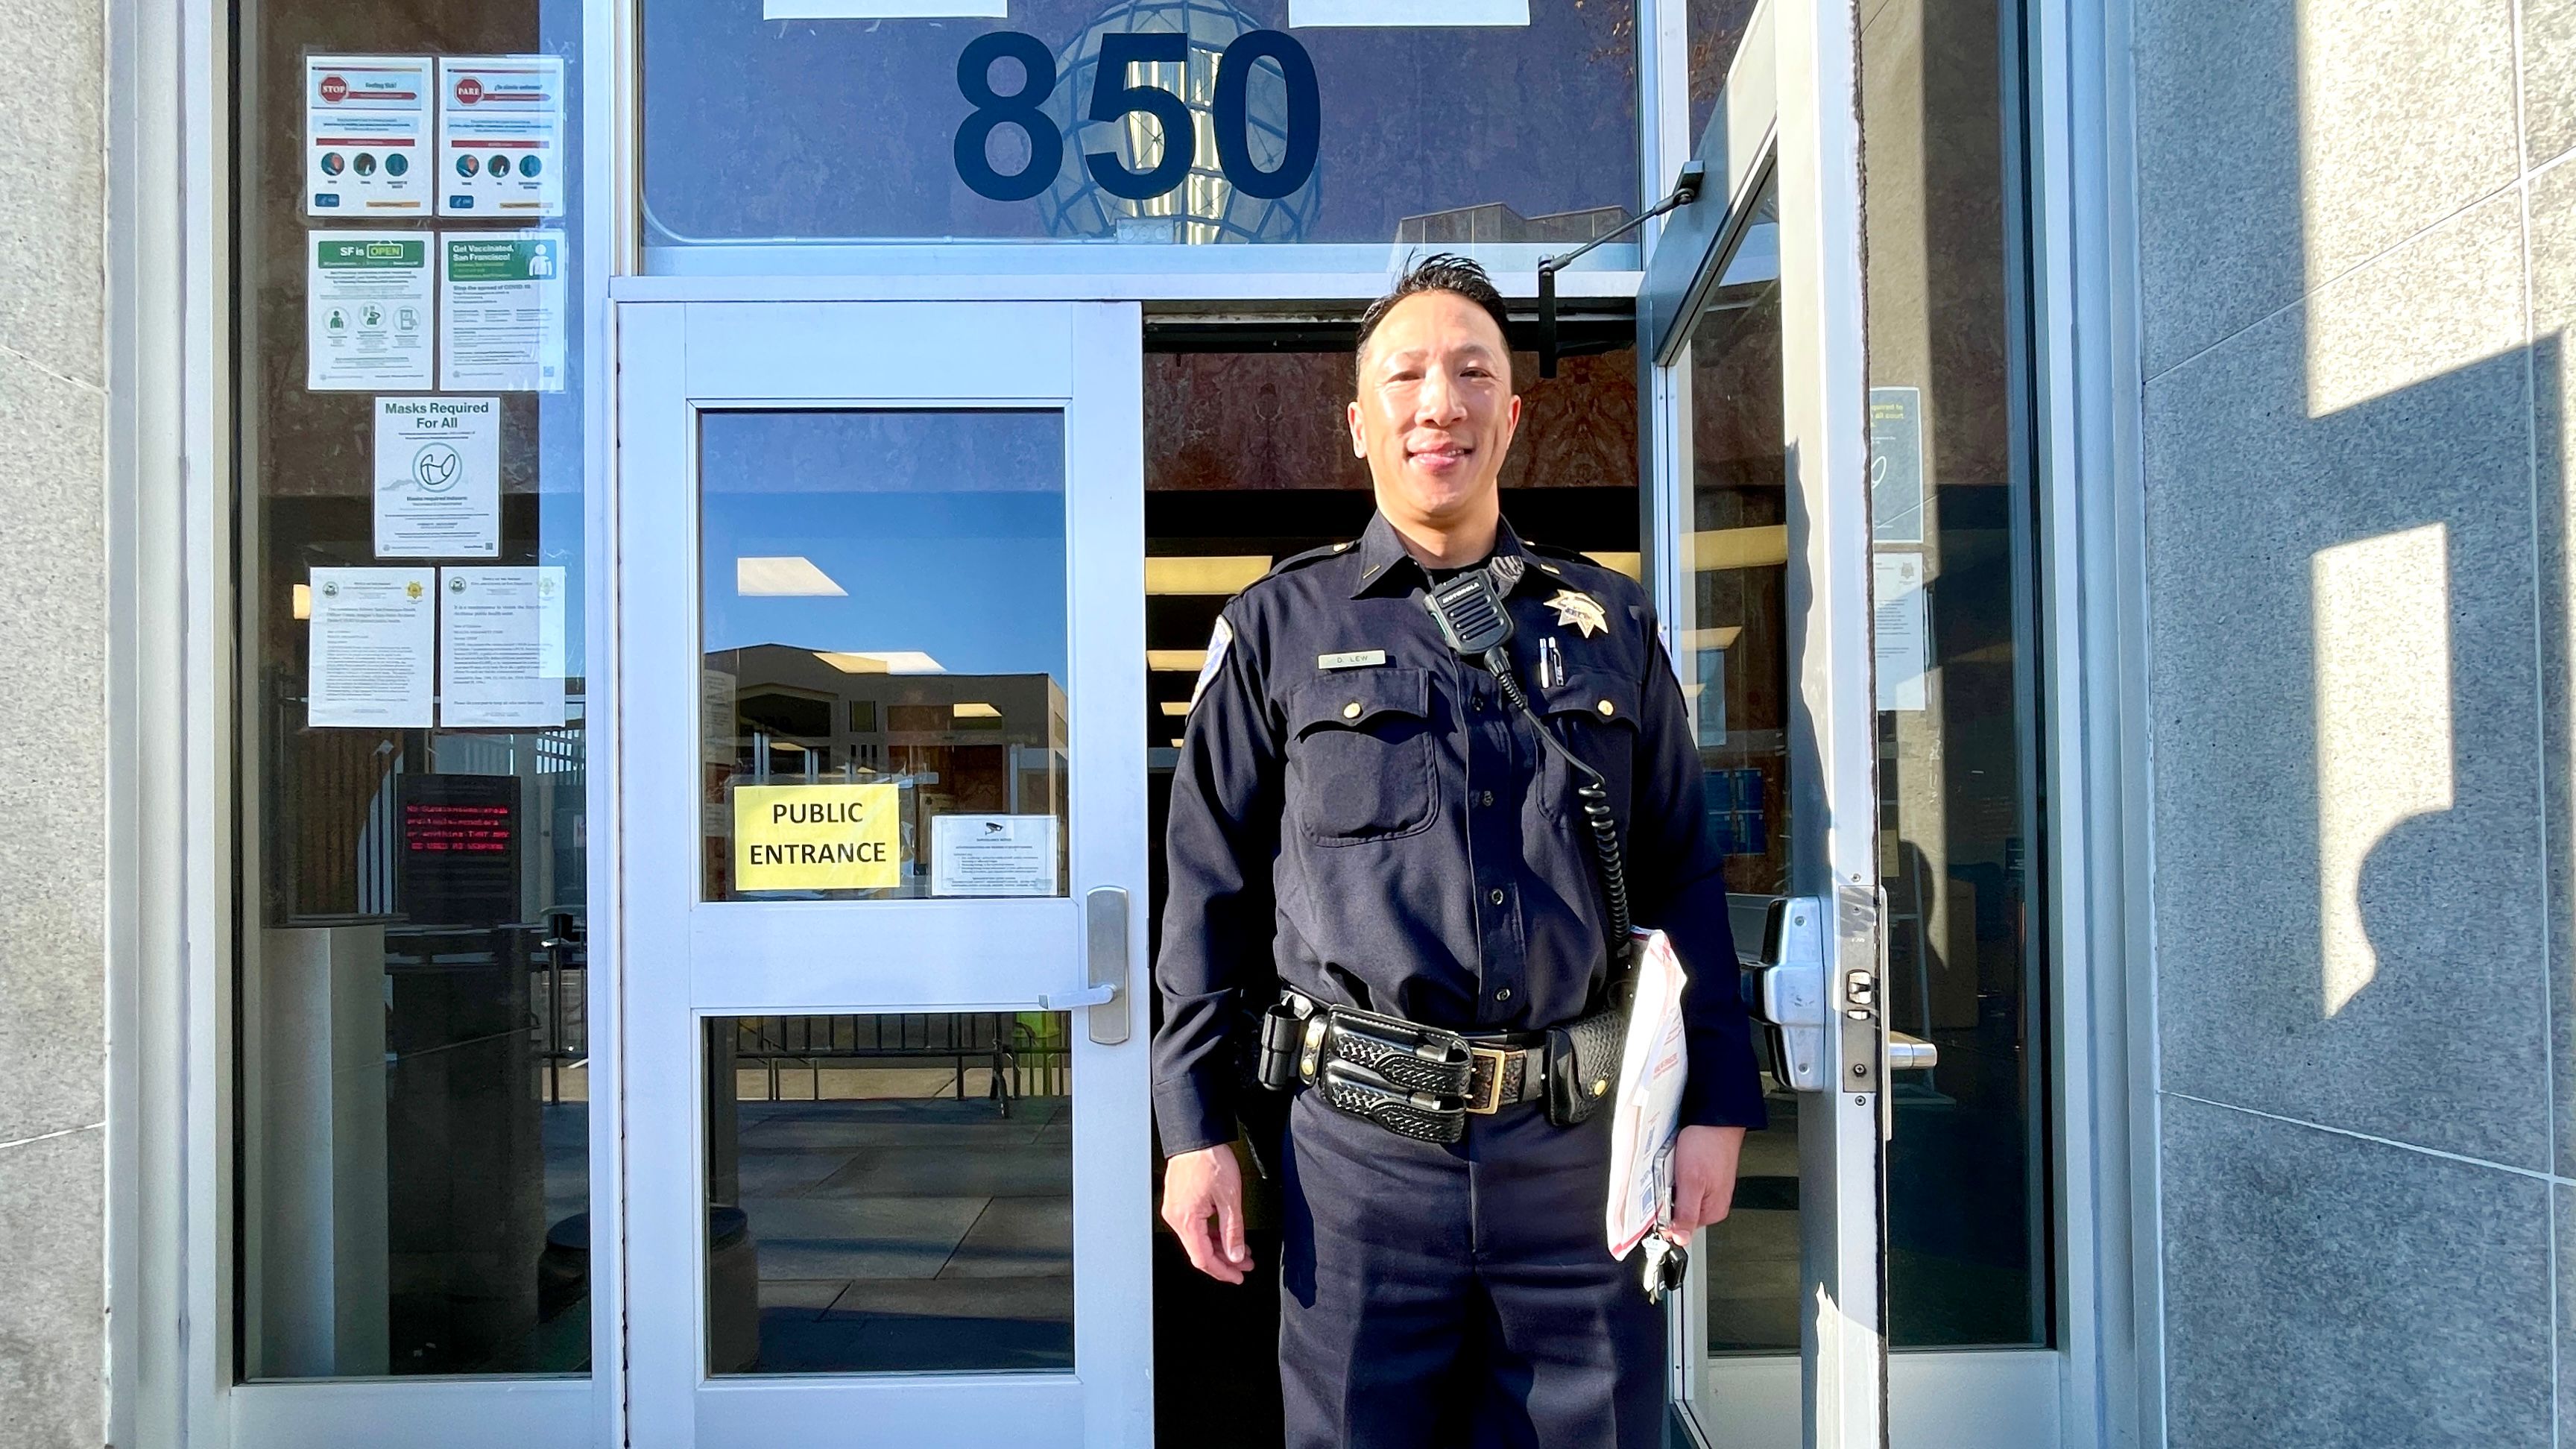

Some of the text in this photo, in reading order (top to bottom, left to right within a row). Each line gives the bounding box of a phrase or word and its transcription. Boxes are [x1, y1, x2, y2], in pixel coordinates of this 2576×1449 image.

[954, 30, 1321, 201] 850
[340, 247, 400, 256] SF is OPEN
[453, 244, 514, 253] Get Vaccinated,
[385, 402, 489, 415] Masks Required
[417, 417, 458, 429] For All
[773, 803, 863, 824] PUBLIC
[751, 842, 886, 865] ENTRANCE
